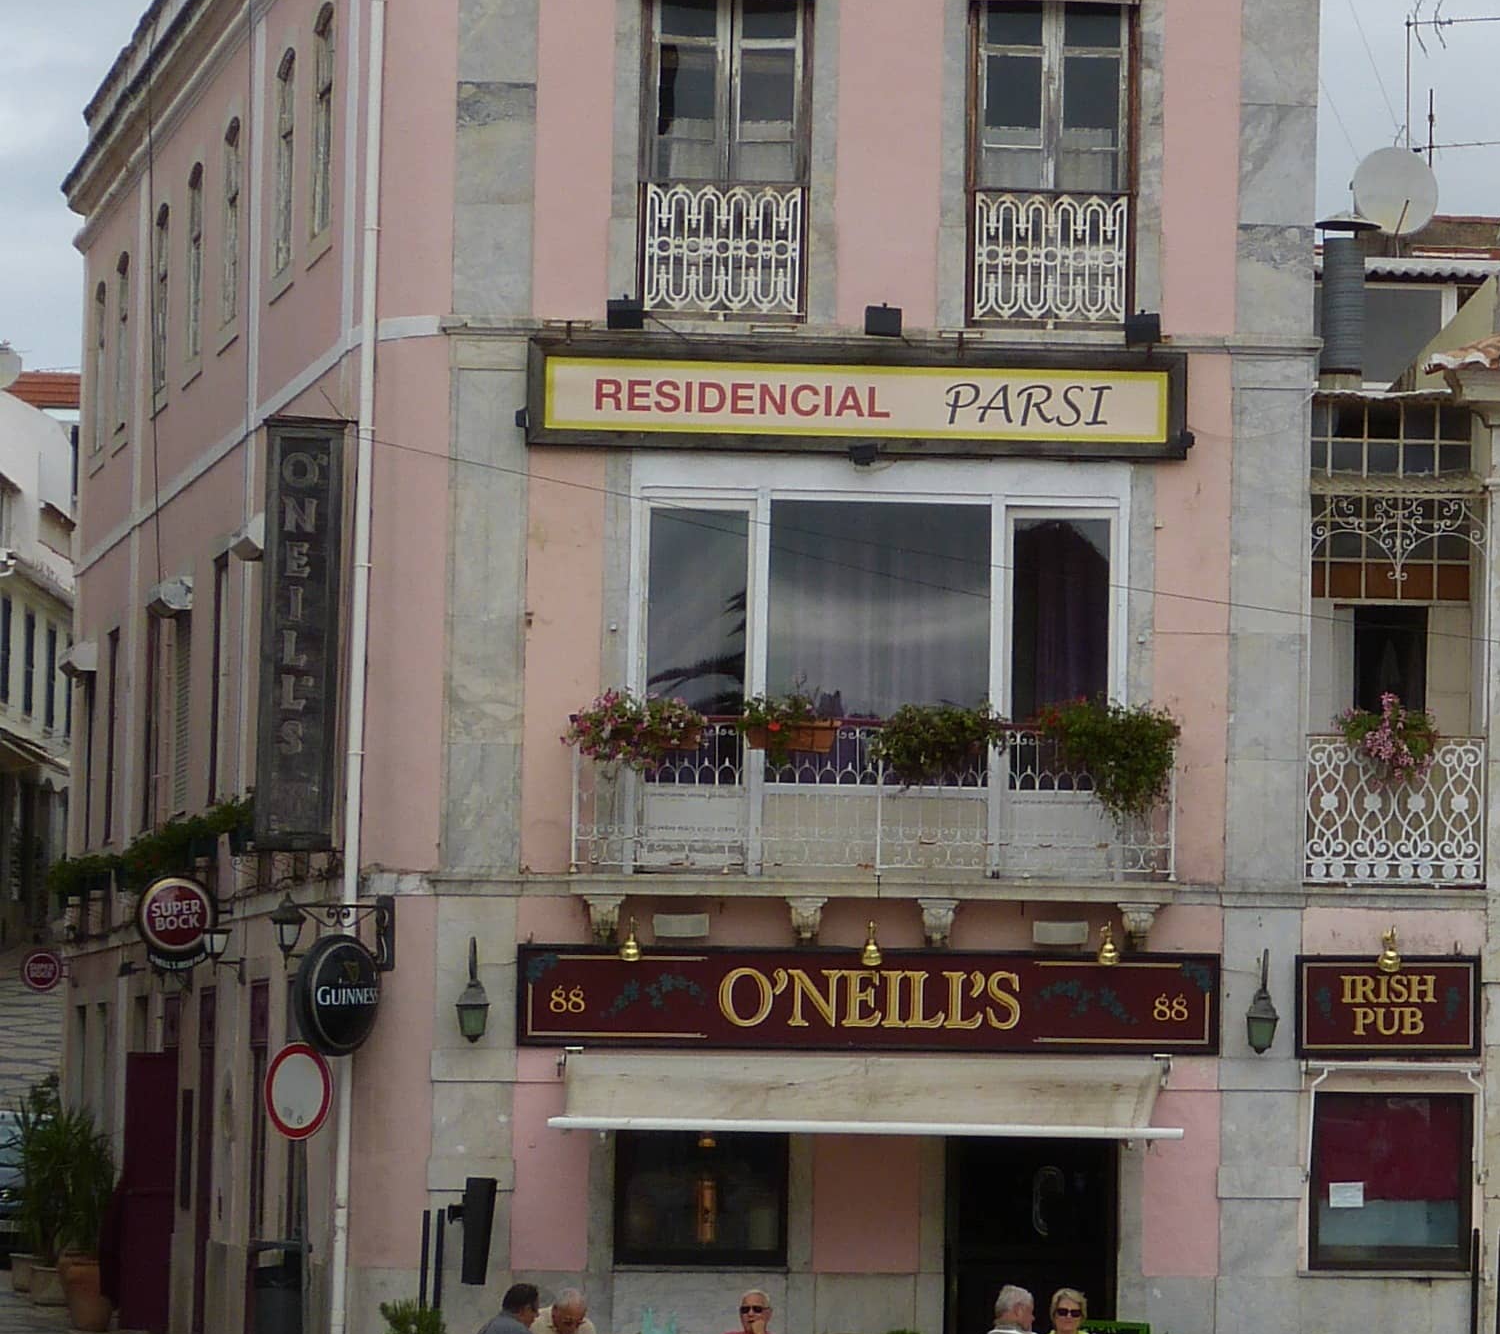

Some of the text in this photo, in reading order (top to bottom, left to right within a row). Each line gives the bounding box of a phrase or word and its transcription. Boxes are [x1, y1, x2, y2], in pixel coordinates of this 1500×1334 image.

[594, 378, 1113, 427] RESIDENCIAL PARSI
[151, 899, 201, 917] SUPER
[155, 914, 200, 931] BOCK
[316, 985, 378, 1006] GUINNESS
[549, 967, 1189, 1031] 88 O'NEILL'S 88
[1340, 974, 1438, 1003] IRISH
[1352, 1007, 1424, 1035] PUB
